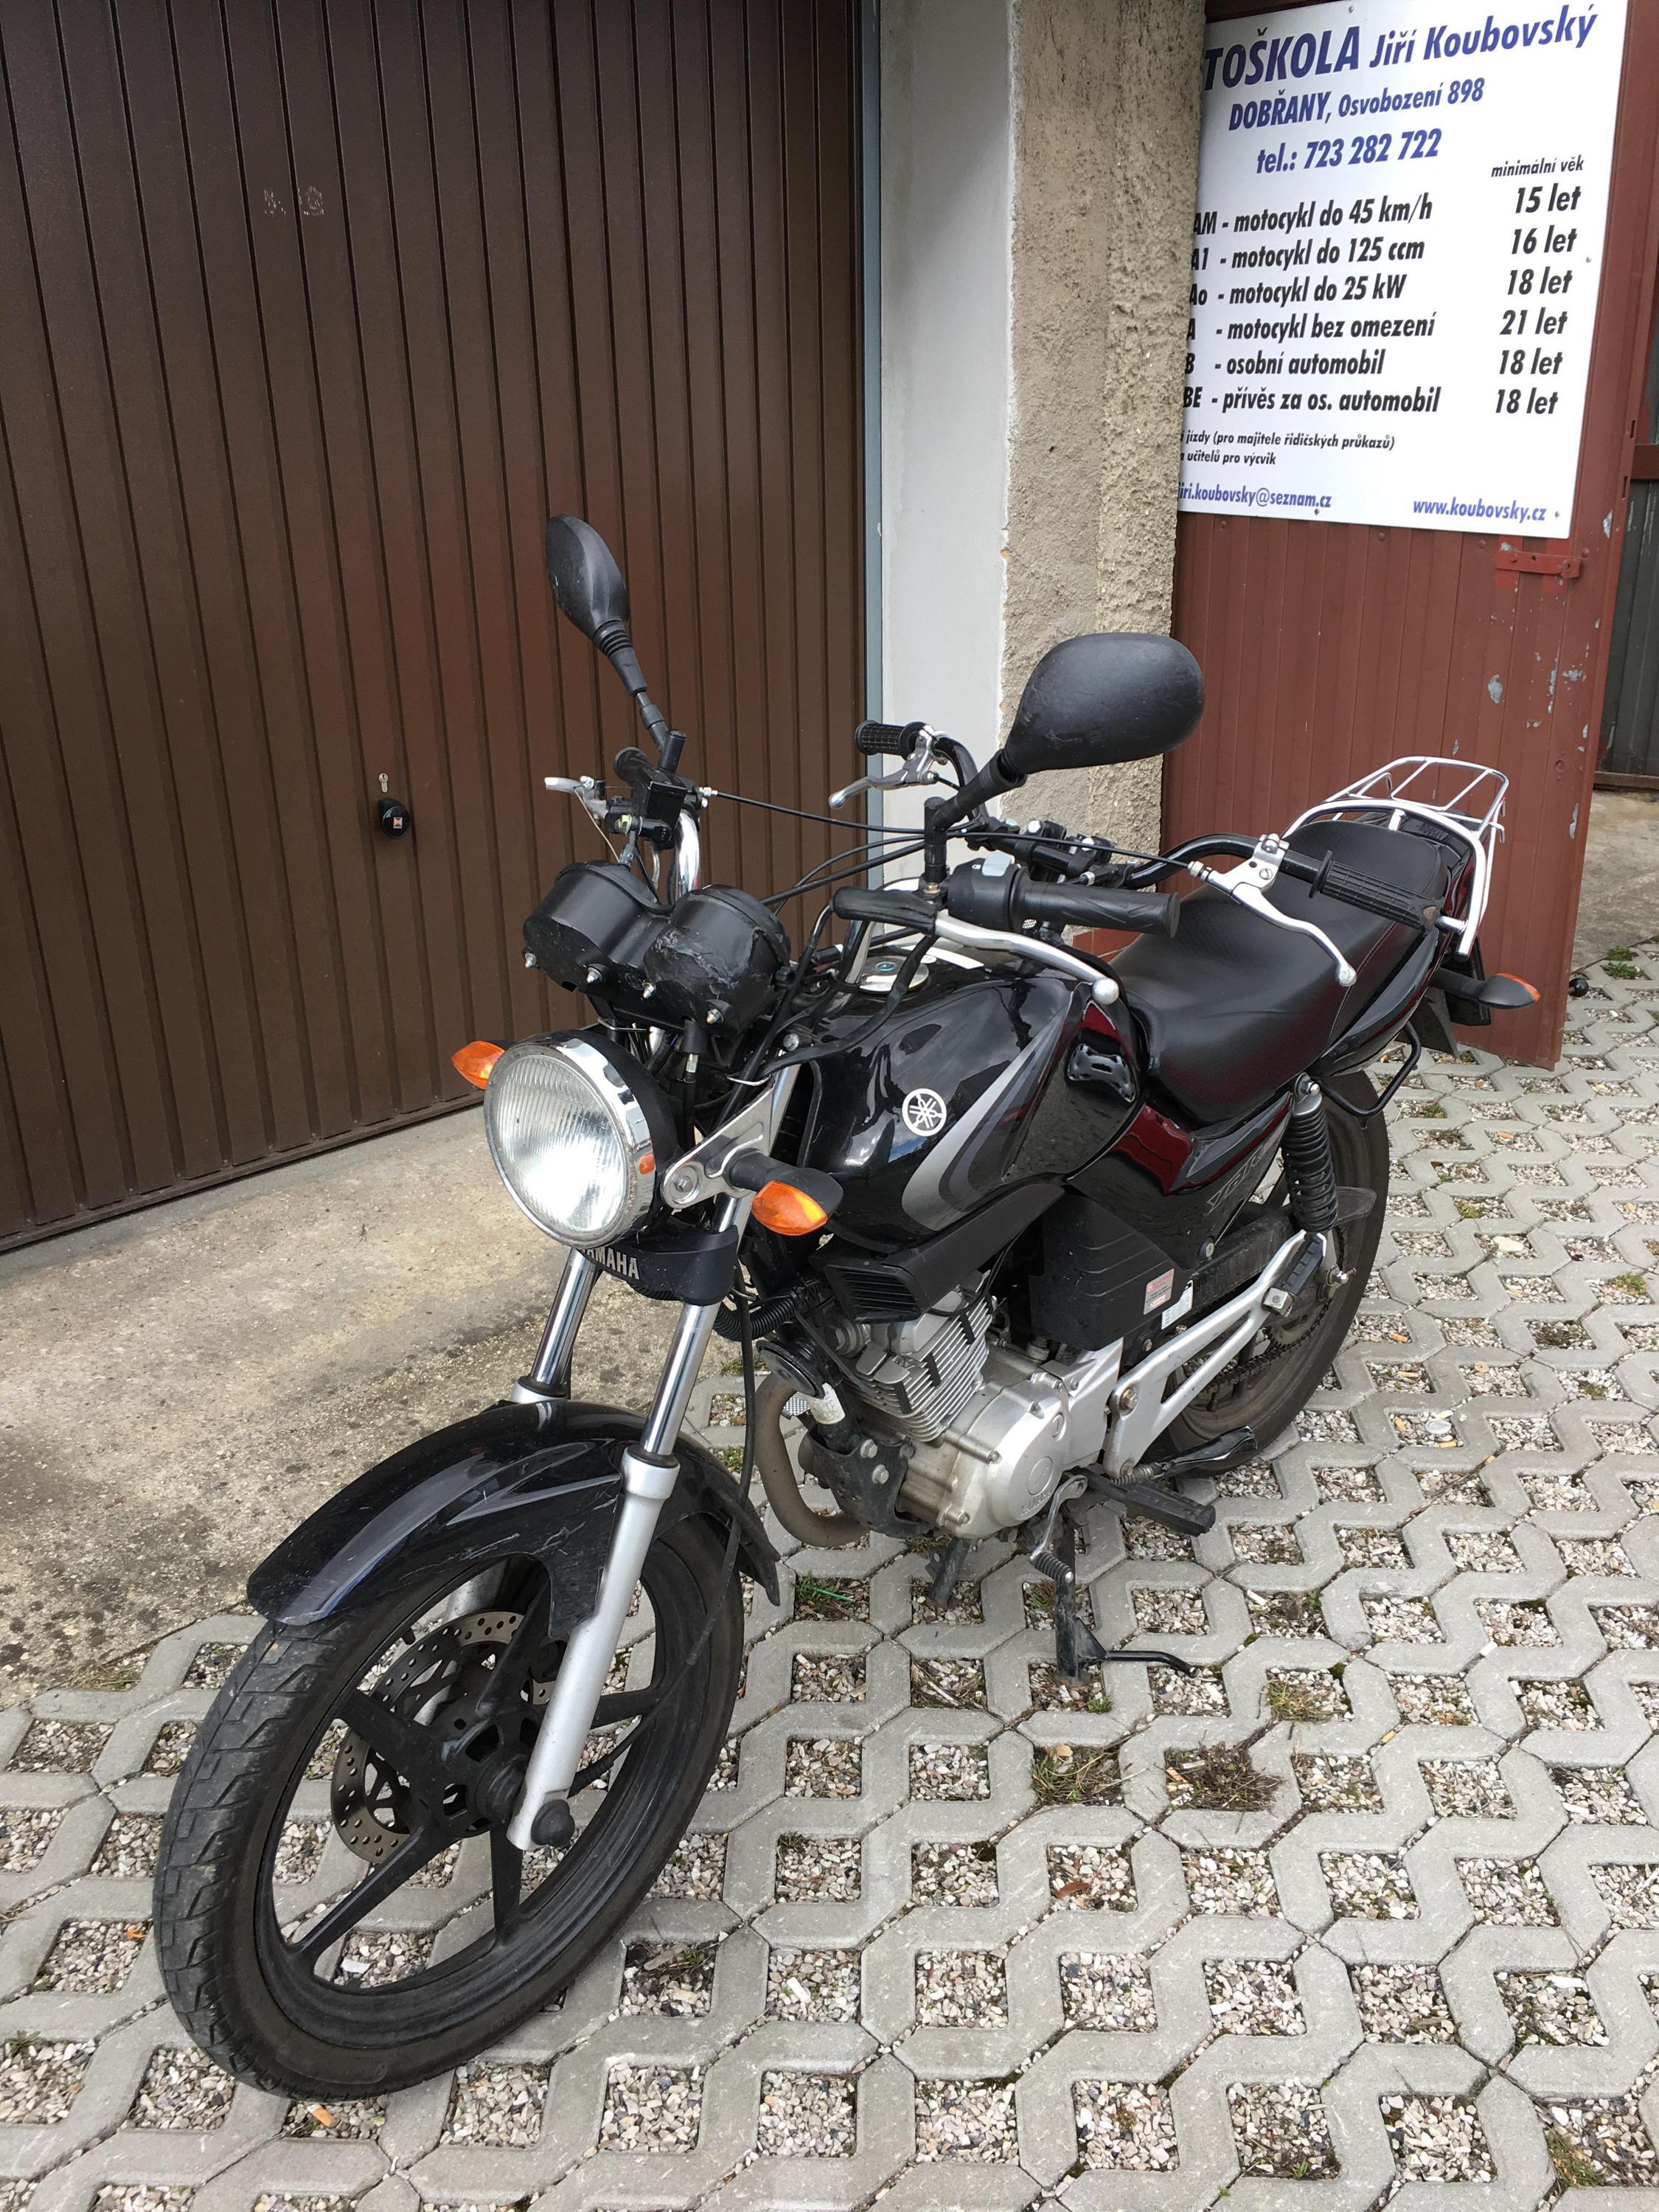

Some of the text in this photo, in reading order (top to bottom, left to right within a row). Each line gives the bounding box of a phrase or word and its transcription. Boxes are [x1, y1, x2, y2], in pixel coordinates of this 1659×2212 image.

[1205, 4, 1598, 91] TOŠKOLA Jiří Koubovský
[1228, 77, 1485, 131] DOBŘANY, Osvobození 898
[1256, 128, 1442, 173] tel.: 723 282 722
[1491, 154, 1585, 177] minimální věk
[1515, 183, 1582, 213] 15 let
[1193, 212, 1217, 235] AM
[1234, 201, 1316, 234] motocykl
[1319, 199, 1343, 226] do
[1349, 198, 1375, 224] 45
[1378, 192, 1433, 223] km/h
[1512, 224, 1577, 254] 16 let
[1191, 247, 1209, 271] A1
[1231, 238, 1313, 271] motocykl
[1316, 237, 1340, 264] do
[1348, 237, 1384, 262] 125
[1388, 241, 1425, 260] ccm
[1229, 276, 1310, 307] motocykl
[1314, 275, 1337, 302] do
[1342, 276, 1368, 300] 25
[1372, 273, 1408, 299] kW
[1507, 266, 1573, 295] 18 let
[1186, 318, 1196, 340] A
[1227, 313, 1307, 344] motocykl
[1311, 313, 1346, 338] bez
[1351, 311, 1437, 338] omezení
[1499, 307, 1568, 335] 21 let
[1185, 352, 1196, 375] B
[1226, 349, 1284, 375] osobní
[1288, 348, 1386, 375] automobil
[1499, 347, 1563, 375] 18 let
[1183, 386, 1203, 408] BE
[1222, 386, 1276, 413] přívěs
[1279, 393, 1303, 409] za
[1307, 393, 1332, 410] os.
[1339, 386, 1441, 412] automobil
[1495, 387, 1559, 414] 18 let
[1186, 429, 1210, 445] jízdy
[1213, 431, 1234, 445] (pro
[1237, 431, 1281, 447] majitele
[1284, 432, 1339, 449] řidičských
[1341, 434, 1395, 451] průkazů)
[1187, 449, 1220, 462] učitelů
[1222, 453, 1241, 465] pro
[1244, 452, 1276, 466] výcvik
[1413, 496, 1547, 524] www.koubovsky.cz
